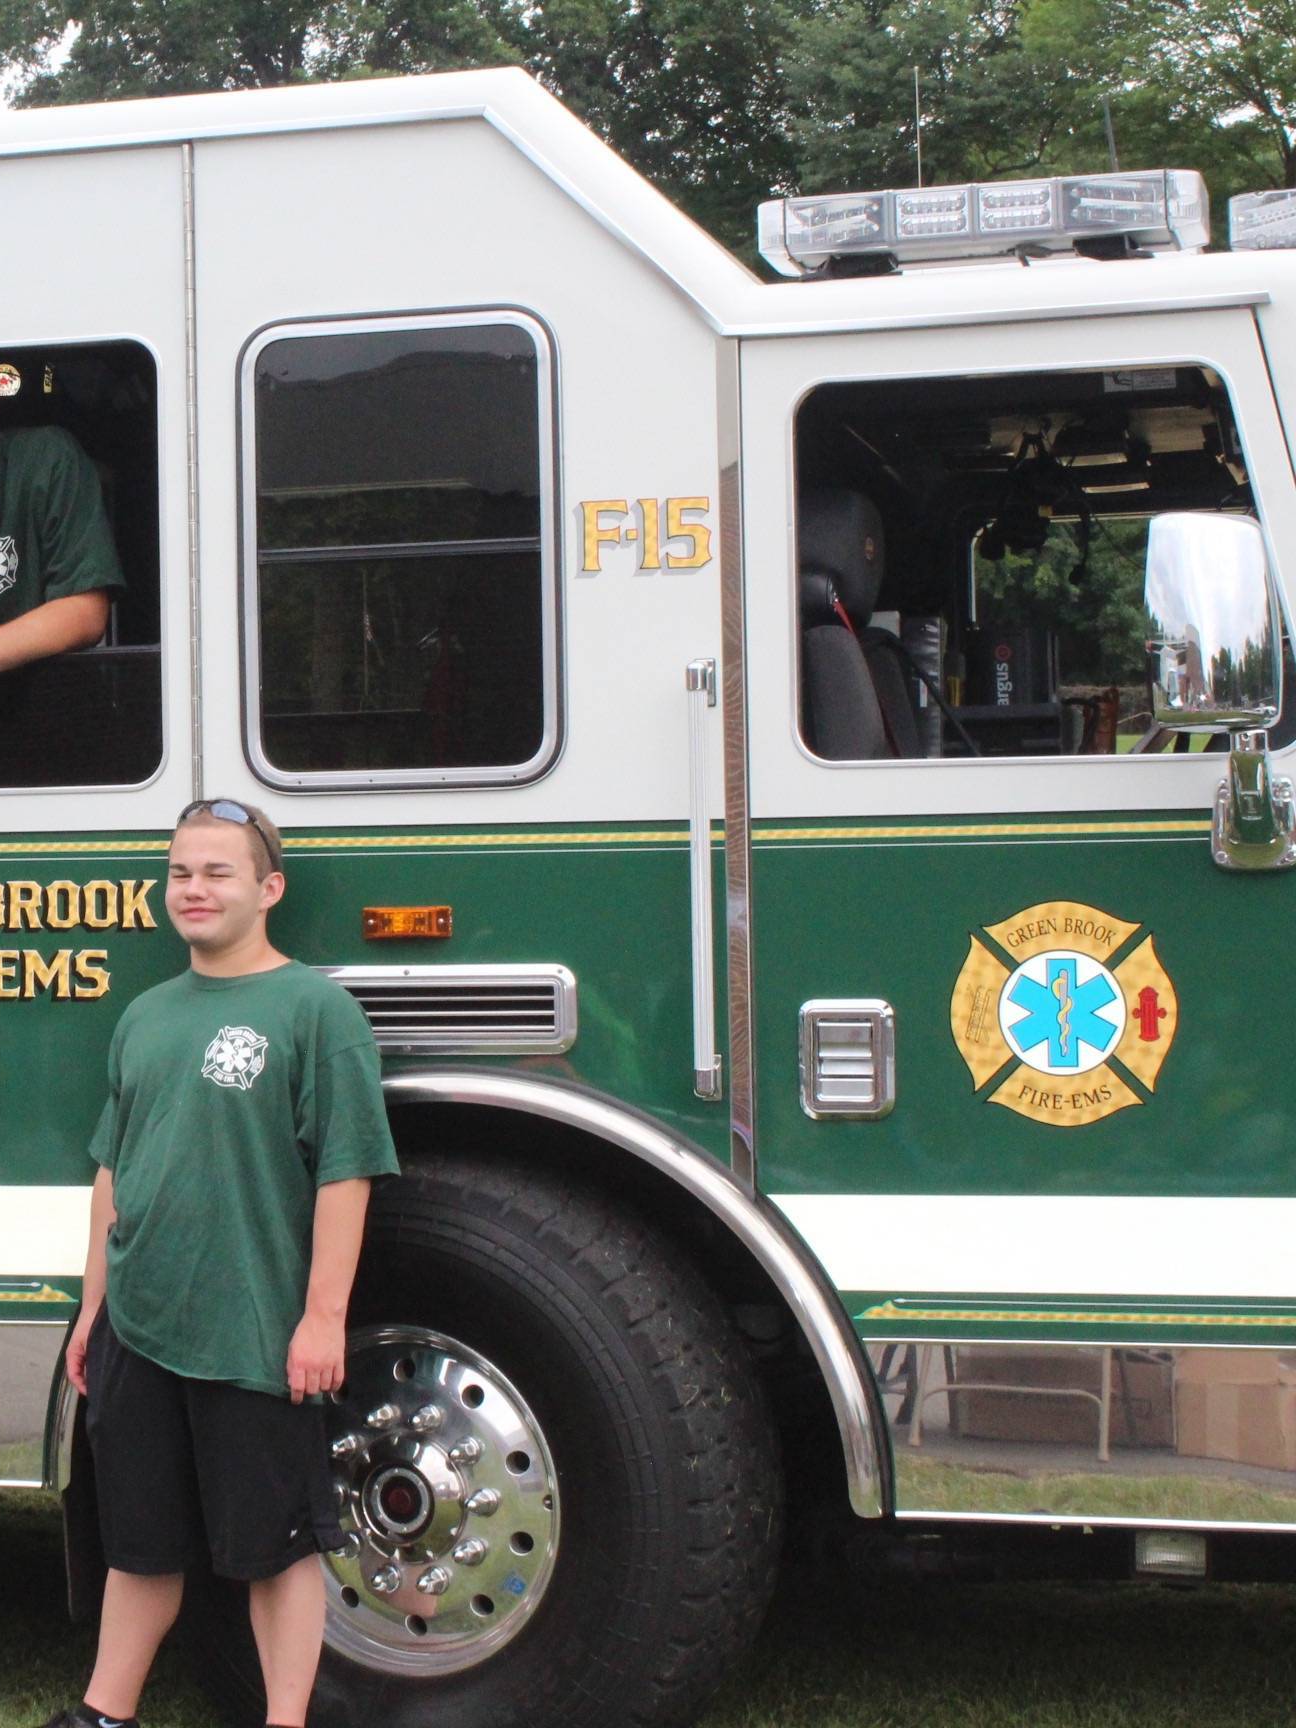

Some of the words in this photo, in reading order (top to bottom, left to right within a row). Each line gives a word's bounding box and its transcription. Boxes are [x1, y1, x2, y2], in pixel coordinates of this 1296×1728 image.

[997, 663, 1012, 706] argus
[1006, 918, 1057, 948] GREEN
[1064, 917, 1116, 947] BROOK
[1018, 1084, 1113, 1110] FIRE-EMS
